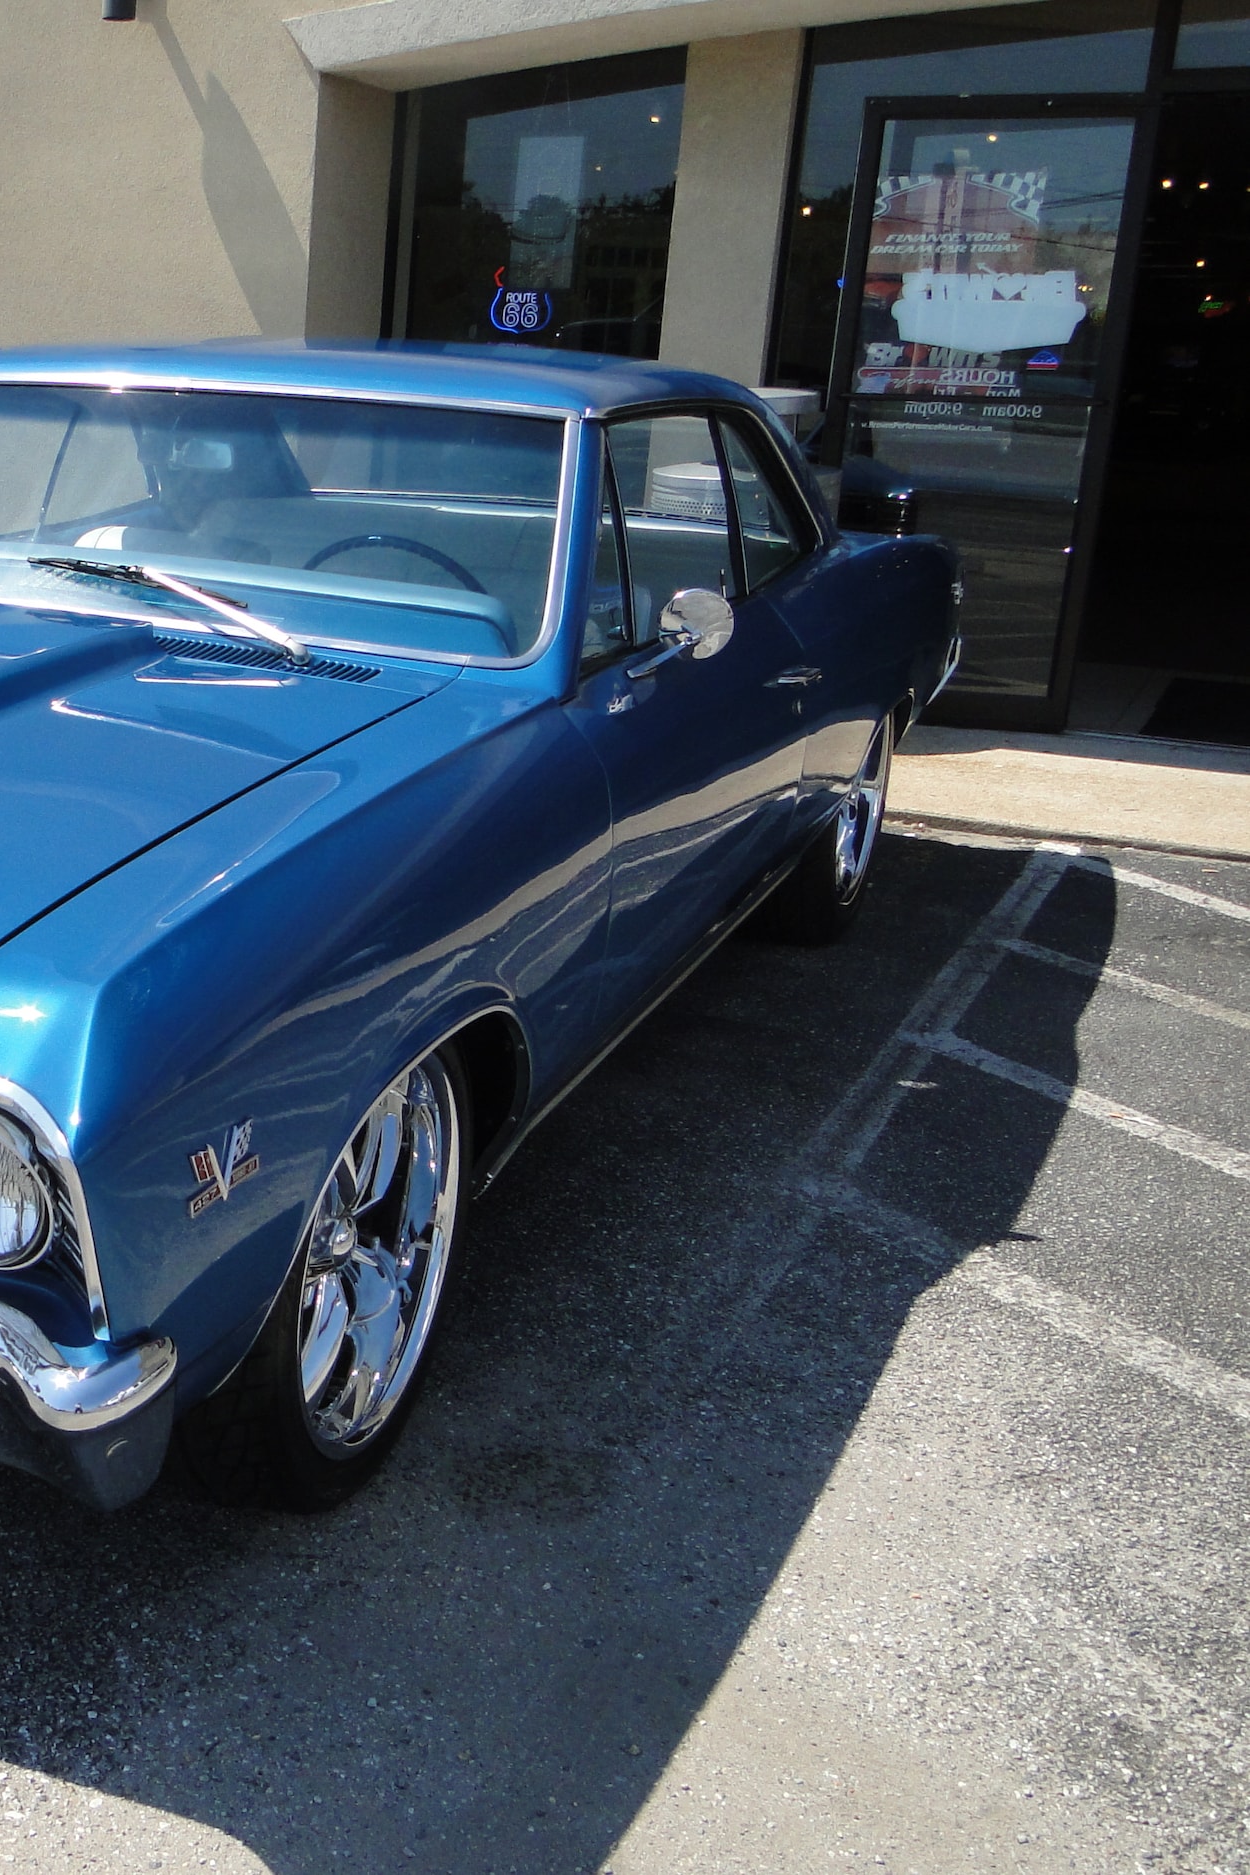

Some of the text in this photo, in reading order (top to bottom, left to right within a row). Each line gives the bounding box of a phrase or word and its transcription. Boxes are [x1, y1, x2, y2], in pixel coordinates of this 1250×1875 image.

[885, 232, 1012, 243] FINANCE YOUR
[870, 243, 1023, 255] DREAM CAR TODAY
[505, 292, 537, 303] ROUTE
[502, 303, 539, 328] 66
[193, 1187, 218, 1212] 427
